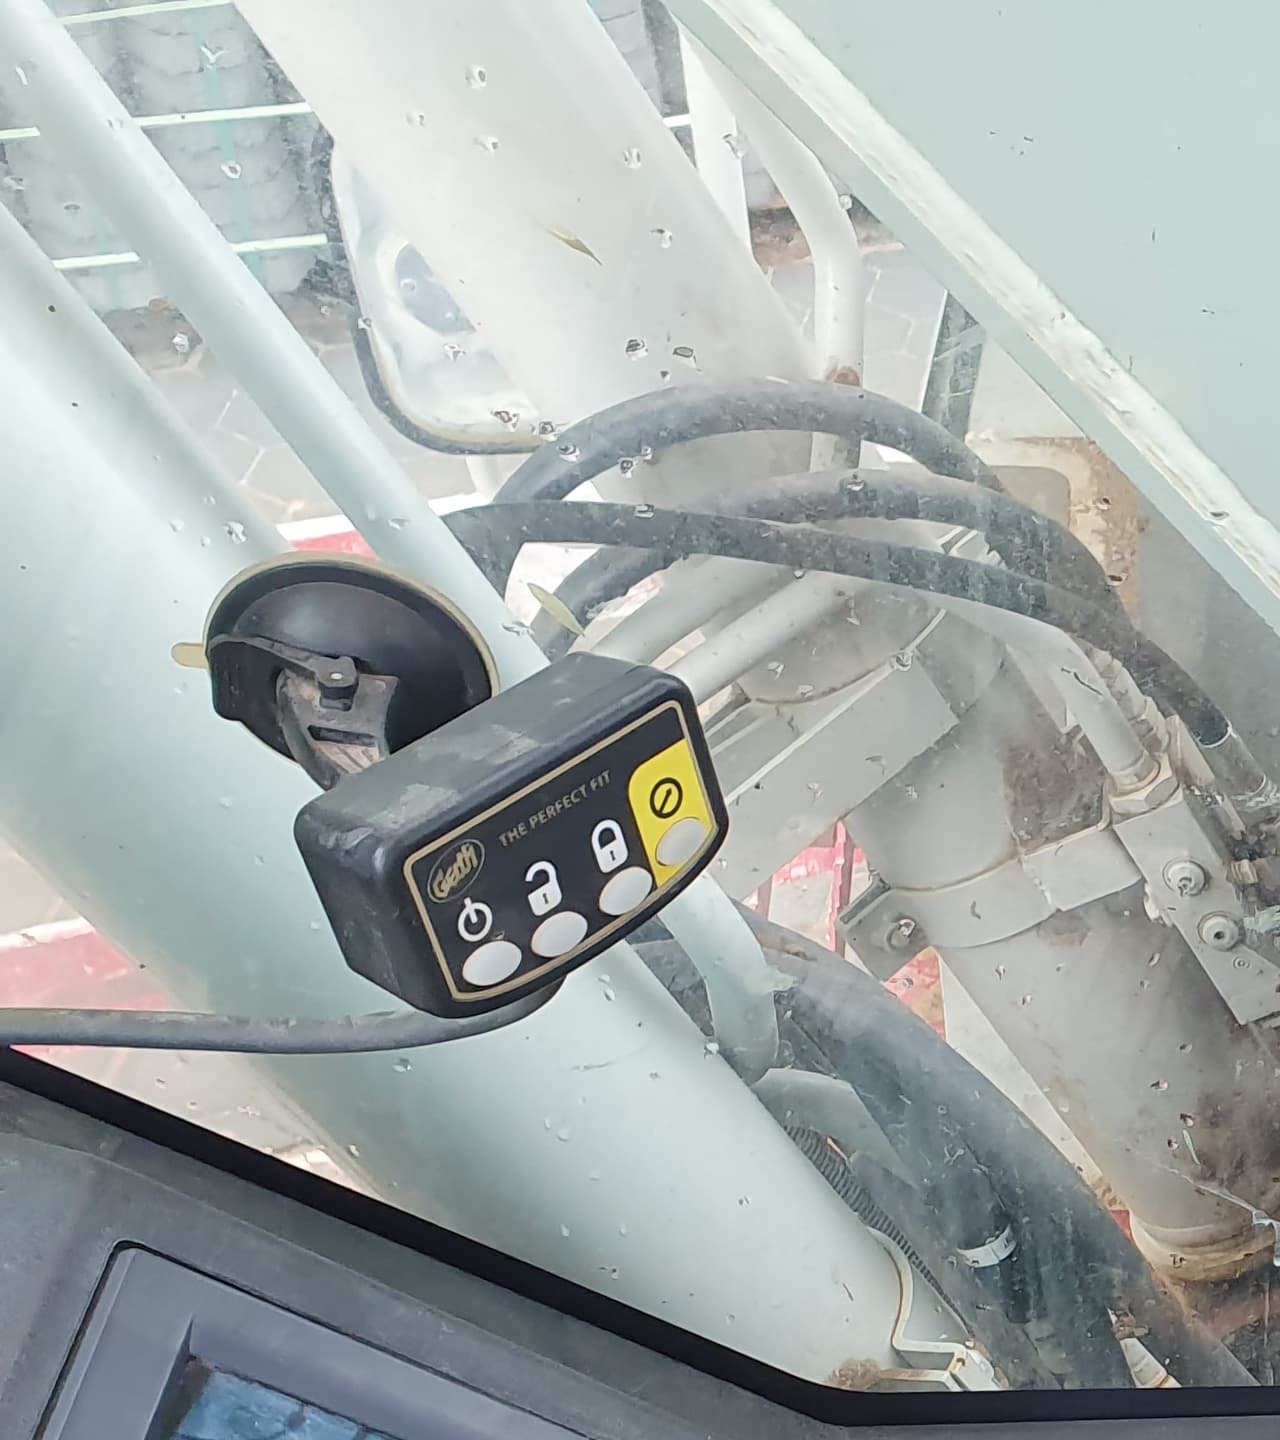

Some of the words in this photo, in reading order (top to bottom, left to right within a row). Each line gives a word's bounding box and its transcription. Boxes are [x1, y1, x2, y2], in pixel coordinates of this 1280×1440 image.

[499, 820, 528, 847] THE
[529, 787, 589, 829] PERFECT
[590, 770, 612, 792] FIT
